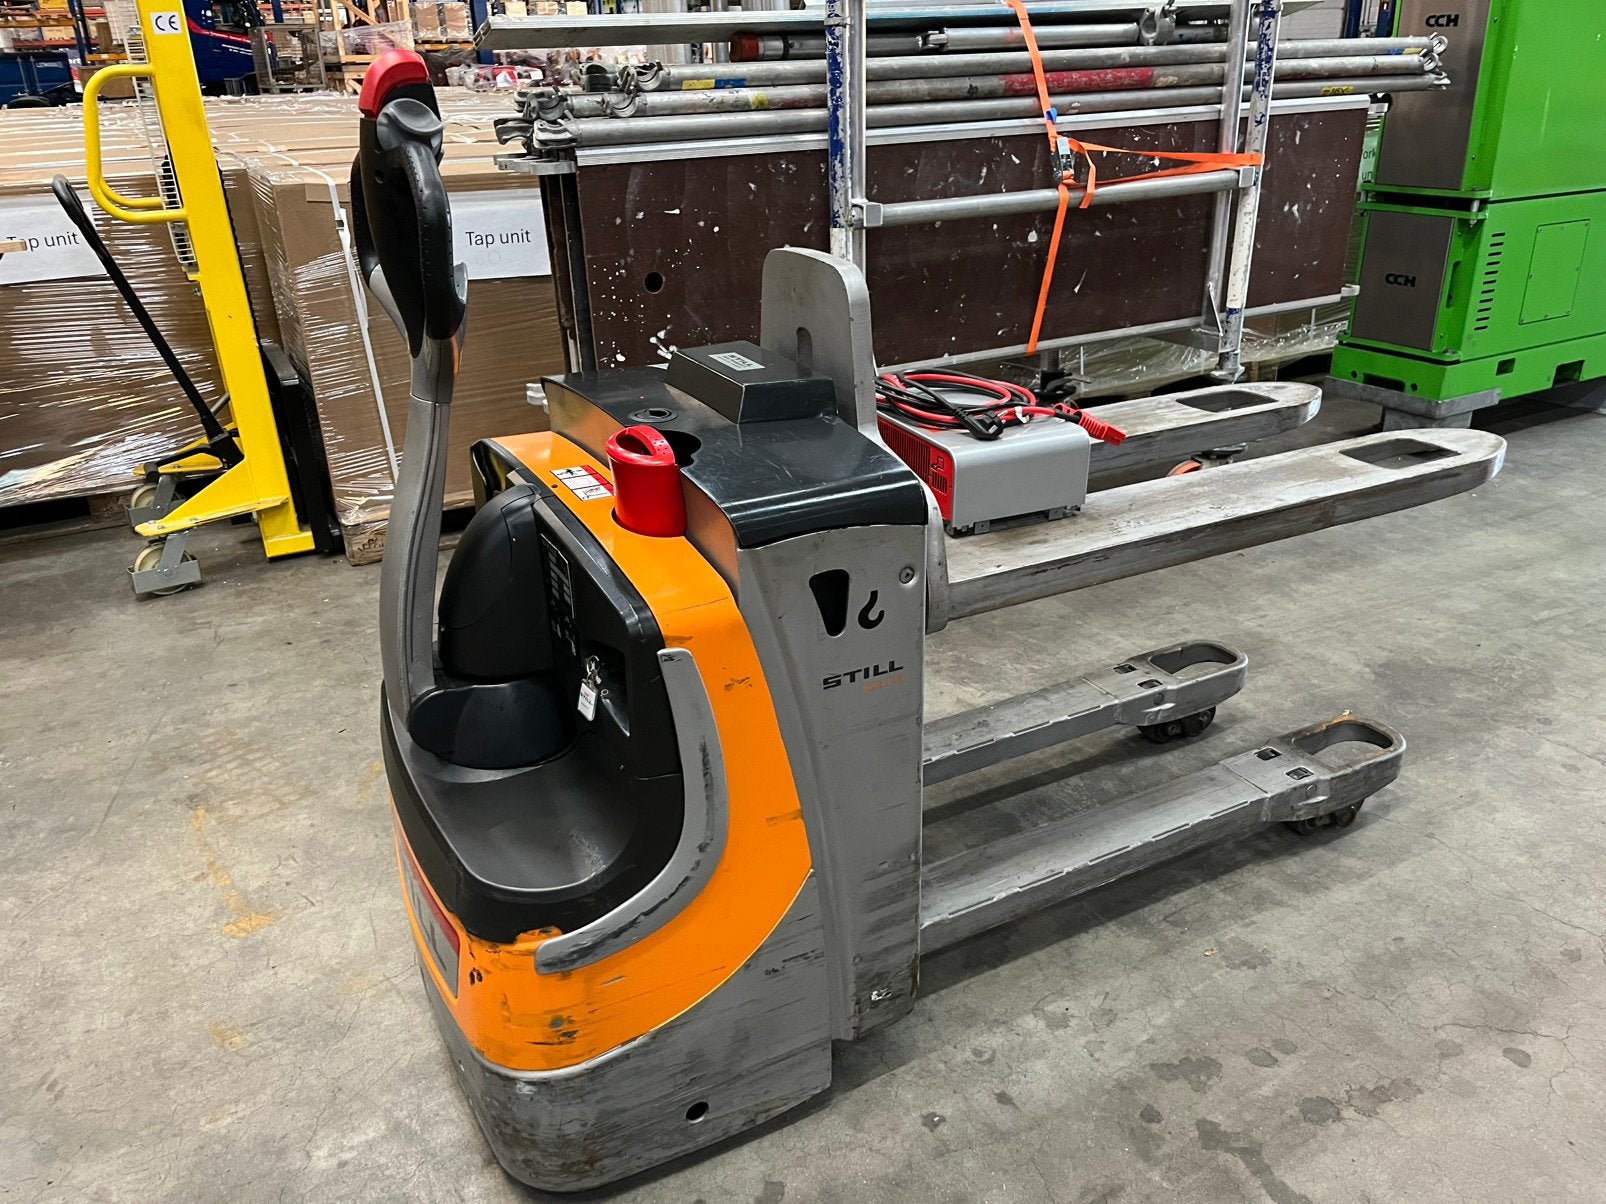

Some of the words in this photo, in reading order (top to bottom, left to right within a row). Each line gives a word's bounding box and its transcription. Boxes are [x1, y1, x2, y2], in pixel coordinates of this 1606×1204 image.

[155, 14, 179, 31] CE
[1425, 14, 1460, 28] CCH
[44, 231, 80, 247] unit
[465, 231, 495, 249] Tap
[499, 228, 532, 244] unit
[1385, 273, 1417, 287] CCH
[822, 660, 904, 690] STILL
